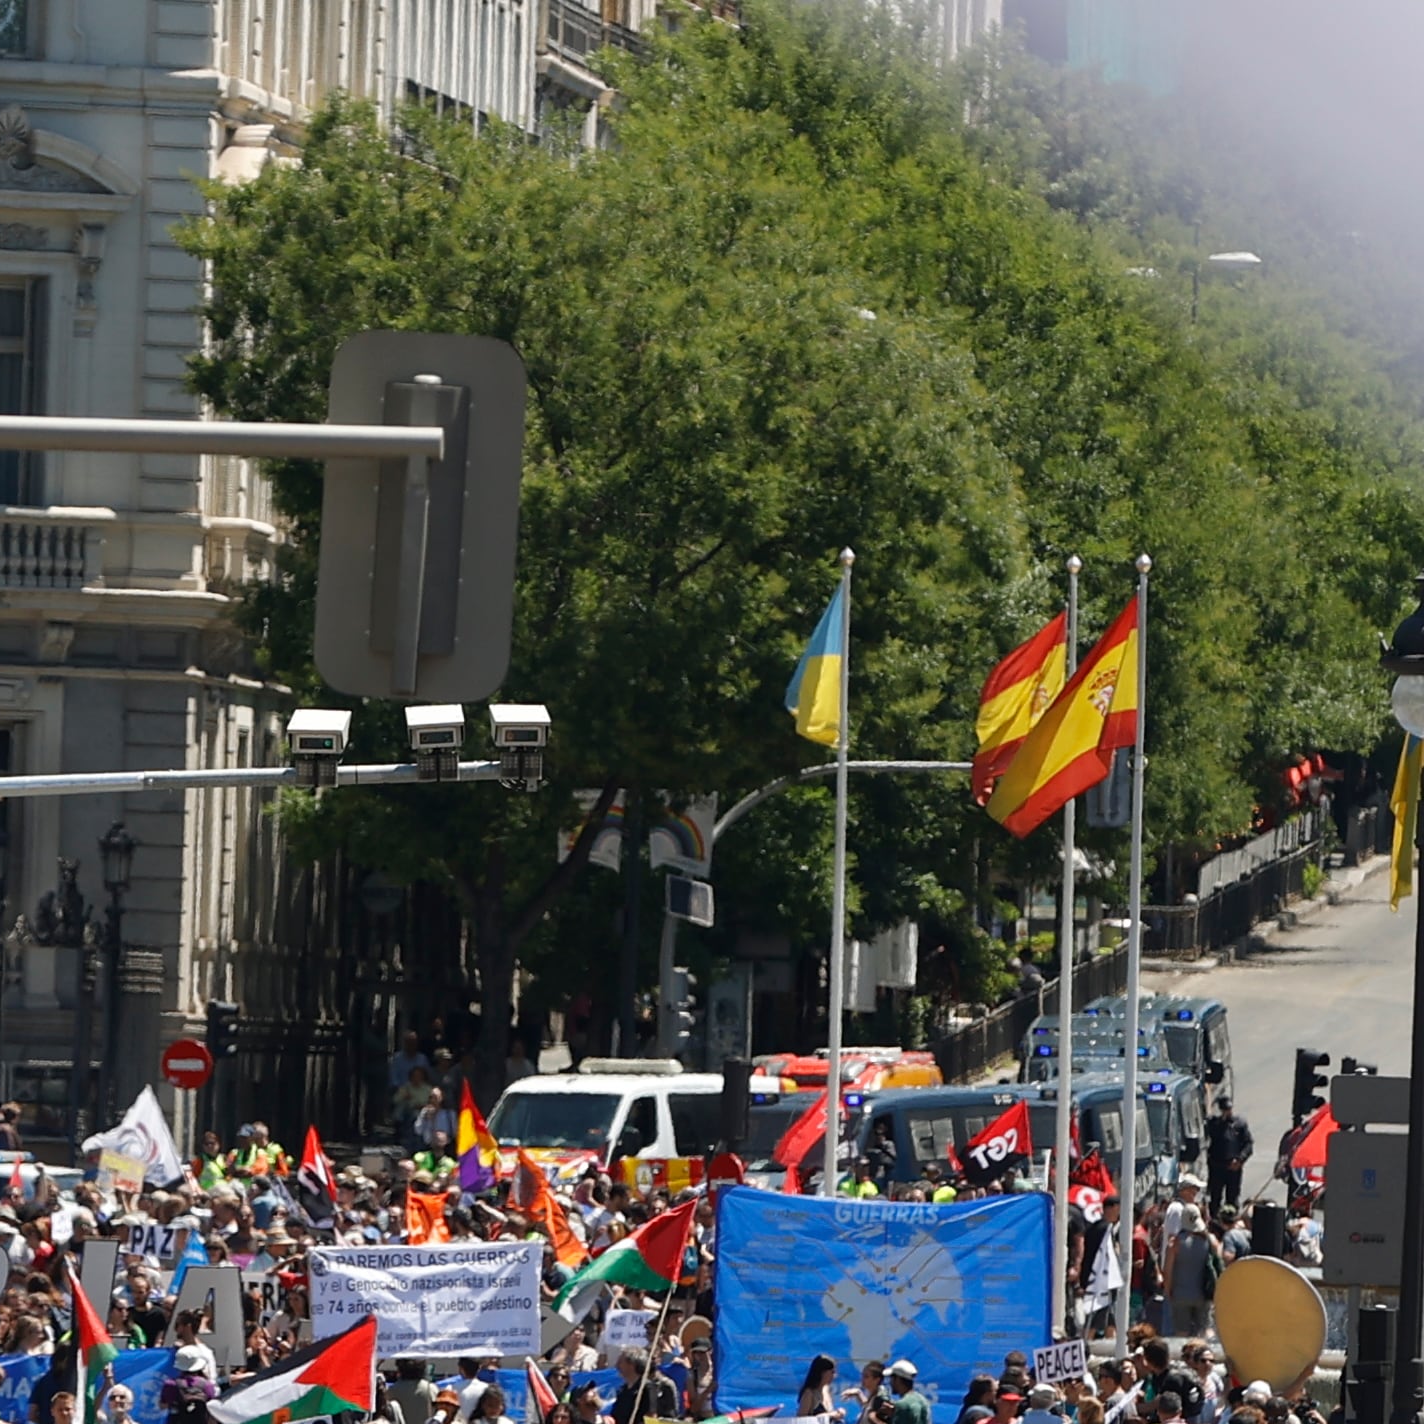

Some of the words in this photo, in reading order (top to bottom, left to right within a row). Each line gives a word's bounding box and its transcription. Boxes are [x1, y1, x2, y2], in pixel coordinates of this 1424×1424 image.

[834, 1203, 940, 1225] GUERRAS
[129, 1225, 175, 1258] PAZ
[335, 1253, 412, 1269] PAREMOS
[417, 1252, 448, 1267] LAS
[320, 1282, 328, 1296] y
[331, 1279, 342, 1292] el
[329, 1300, 344, 1314] 74
[347, 1300, 379, 1314] años
[436, 1298, 476, 1312] pueblo
[480, 1295, 533, 1312] palestino
[1037, 1342, 1084, 1381] PEACE!
